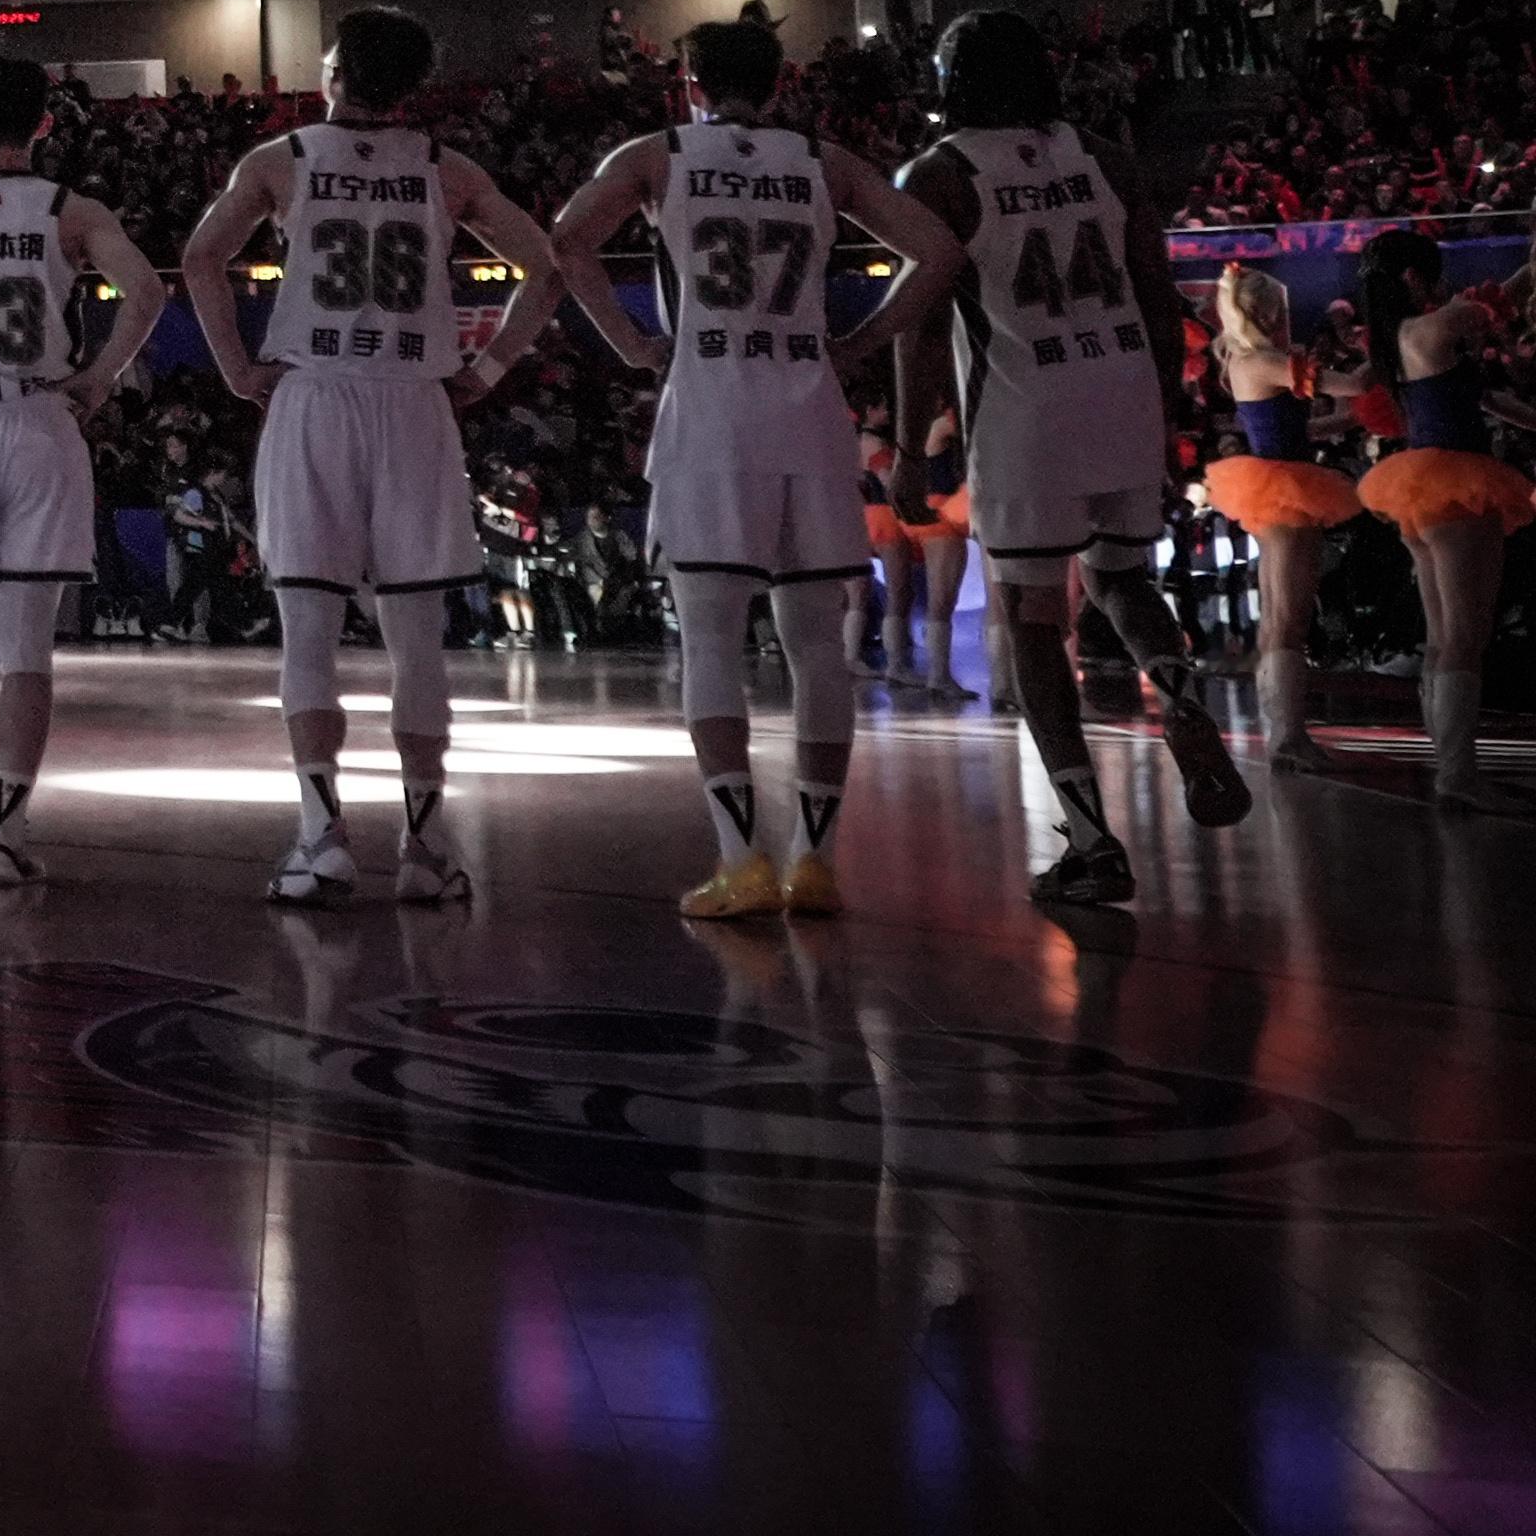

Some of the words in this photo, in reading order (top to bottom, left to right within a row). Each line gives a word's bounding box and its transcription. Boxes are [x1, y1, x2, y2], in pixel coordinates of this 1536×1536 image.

[310, 172, 427, 204] 辽宁本钢
[689, 169, 812, 205] 辽宁本钢
[994, 173, 1095, 216] 辽宁本钢
[311, 219, 429, 314] 36
[691, 217, 815, 316] 37
[1011, 218, 1127, 318] 44
